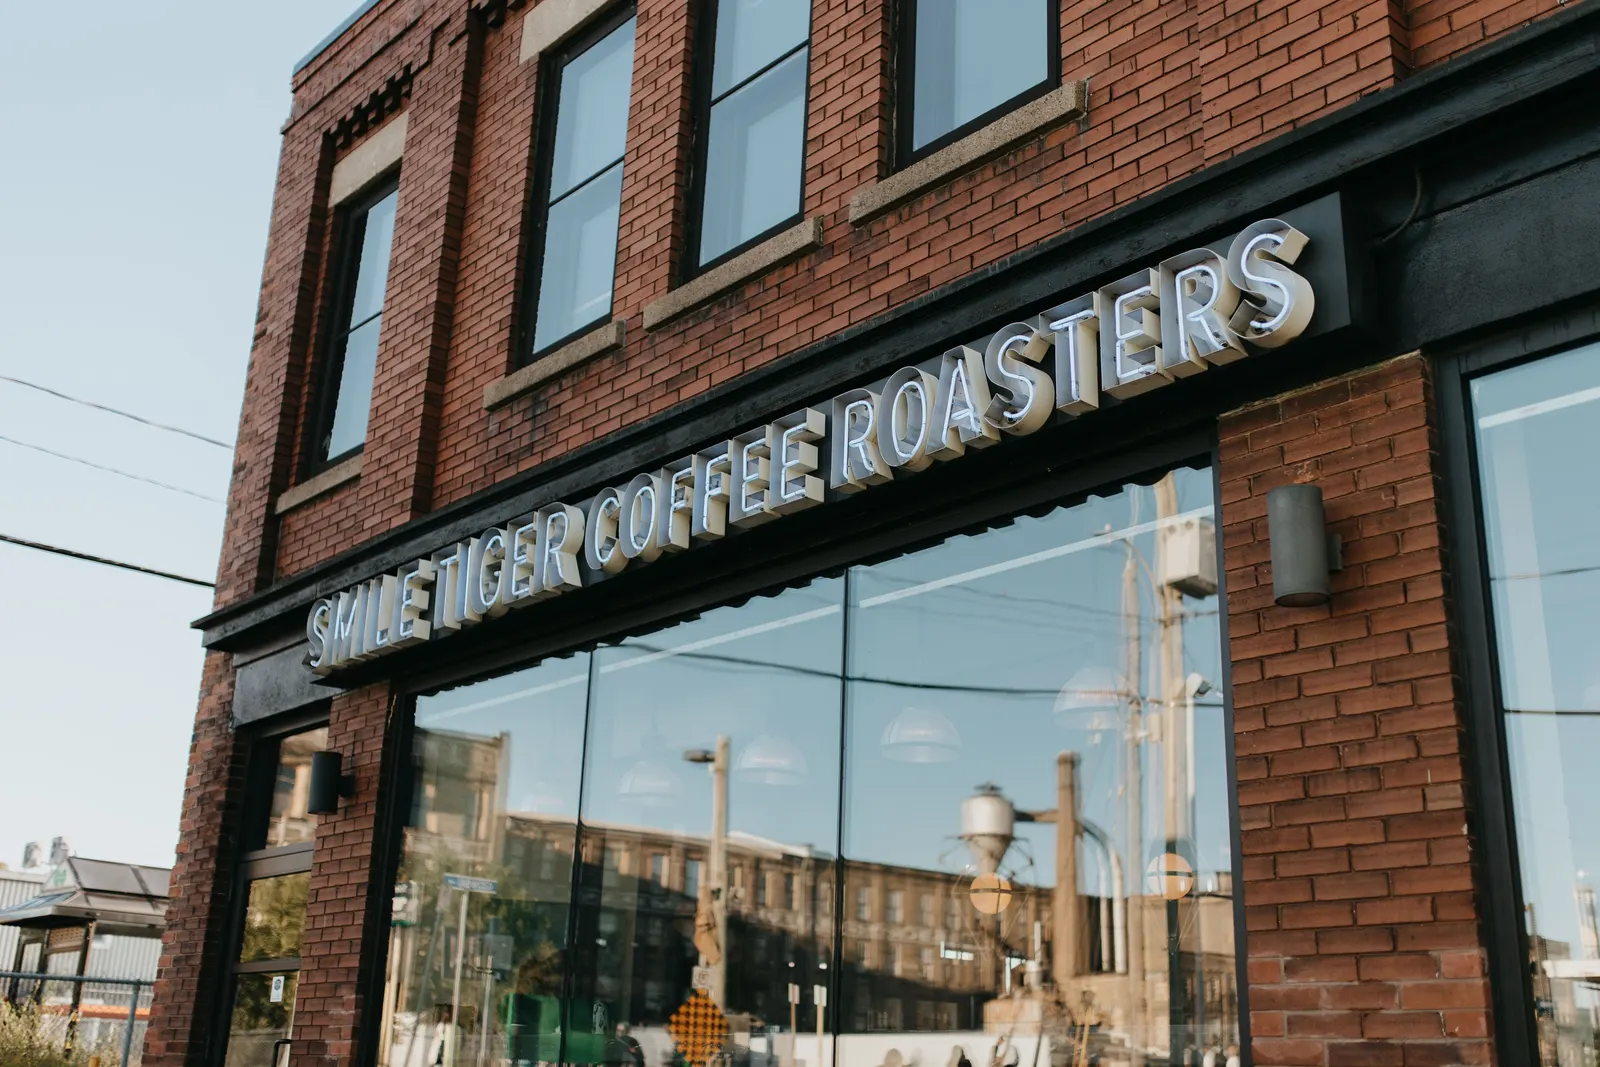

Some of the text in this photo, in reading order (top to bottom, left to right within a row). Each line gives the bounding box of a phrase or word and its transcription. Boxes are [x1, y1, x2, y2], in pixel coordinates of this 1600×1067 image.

[303, 218, 1315, 675] SMILE TIGER COFFEE ROASTERS
